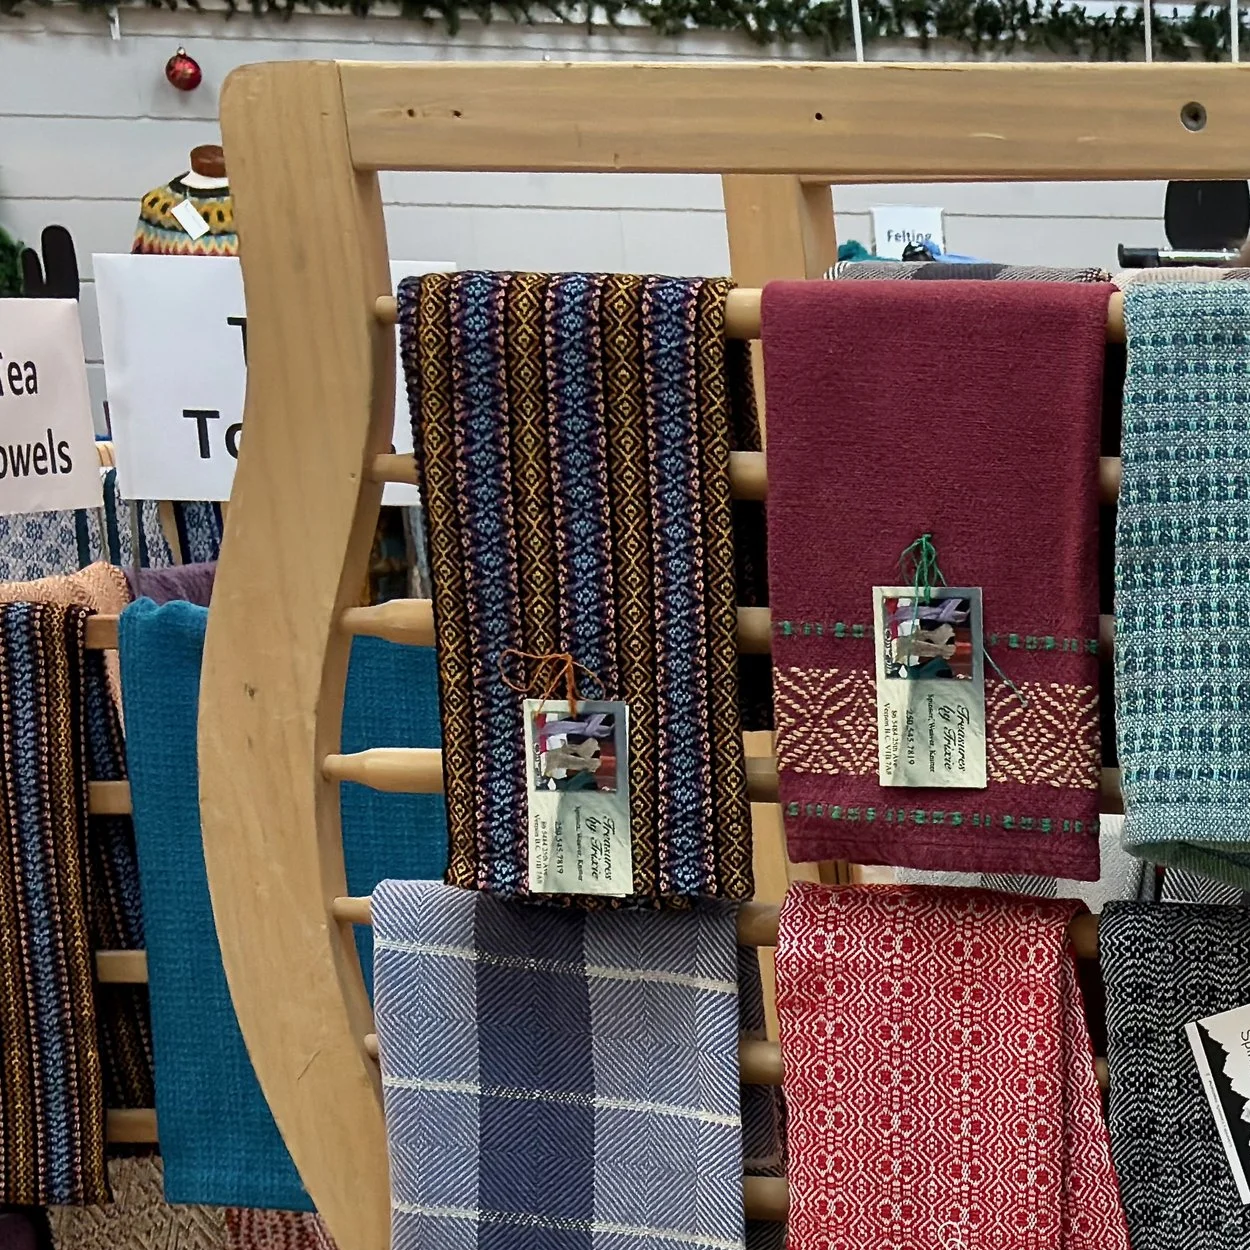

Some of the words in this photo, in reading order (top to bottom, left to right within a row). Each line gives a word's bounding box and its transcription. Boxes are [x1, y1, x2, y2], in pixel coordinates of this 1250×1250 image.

[886, 228, 932, 245] Felting
[937, 705, 956, 723] by
[943, 726, 957, 770] Trixie
[956, 704, 970, 772] Treasures
[584, 816, 602, 833] by
[590, 836, 603, 880] Trixie
[602, 815, 616, 880] Treasures
